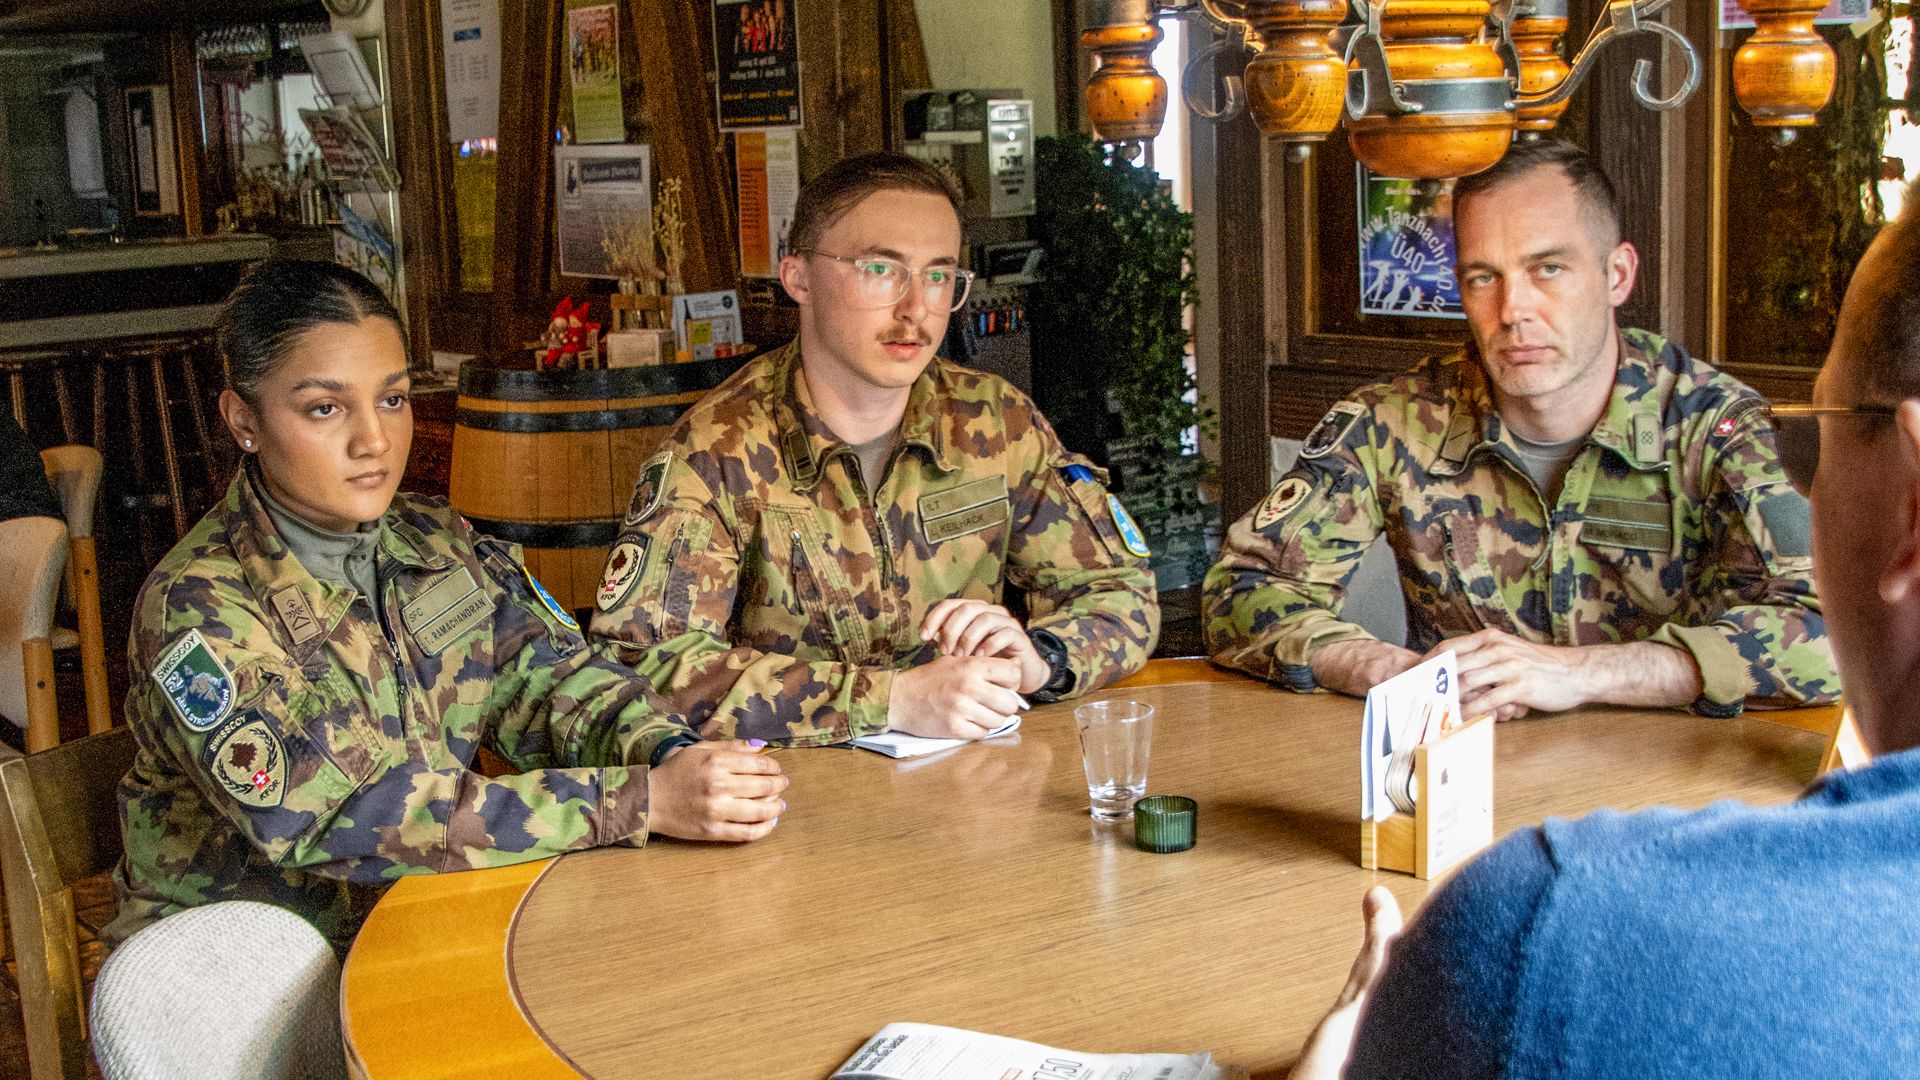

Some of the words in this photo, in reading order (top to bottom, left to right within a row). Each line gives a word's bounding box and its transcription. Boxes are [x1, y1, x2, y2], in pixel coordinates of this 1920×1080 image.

[1391, 232, 1425, 274] Ü40
[940, 513, 985, 533] KEILHACK
[600, 592, 617, 601] KFOR
[408, 607, 424, 623] SFC
[432, 599, 487, 640] RAMACHANDRAN
[156, 635, 196, 681] SWISSCOY
[165, 671, 186, 694] 52
[188, 713, 217, 727] STRONG
[215, 688, 230, 716] READY
[209, 715, 247, 753] SWISSCOY
[258, 778, 281, 801] KFOR
